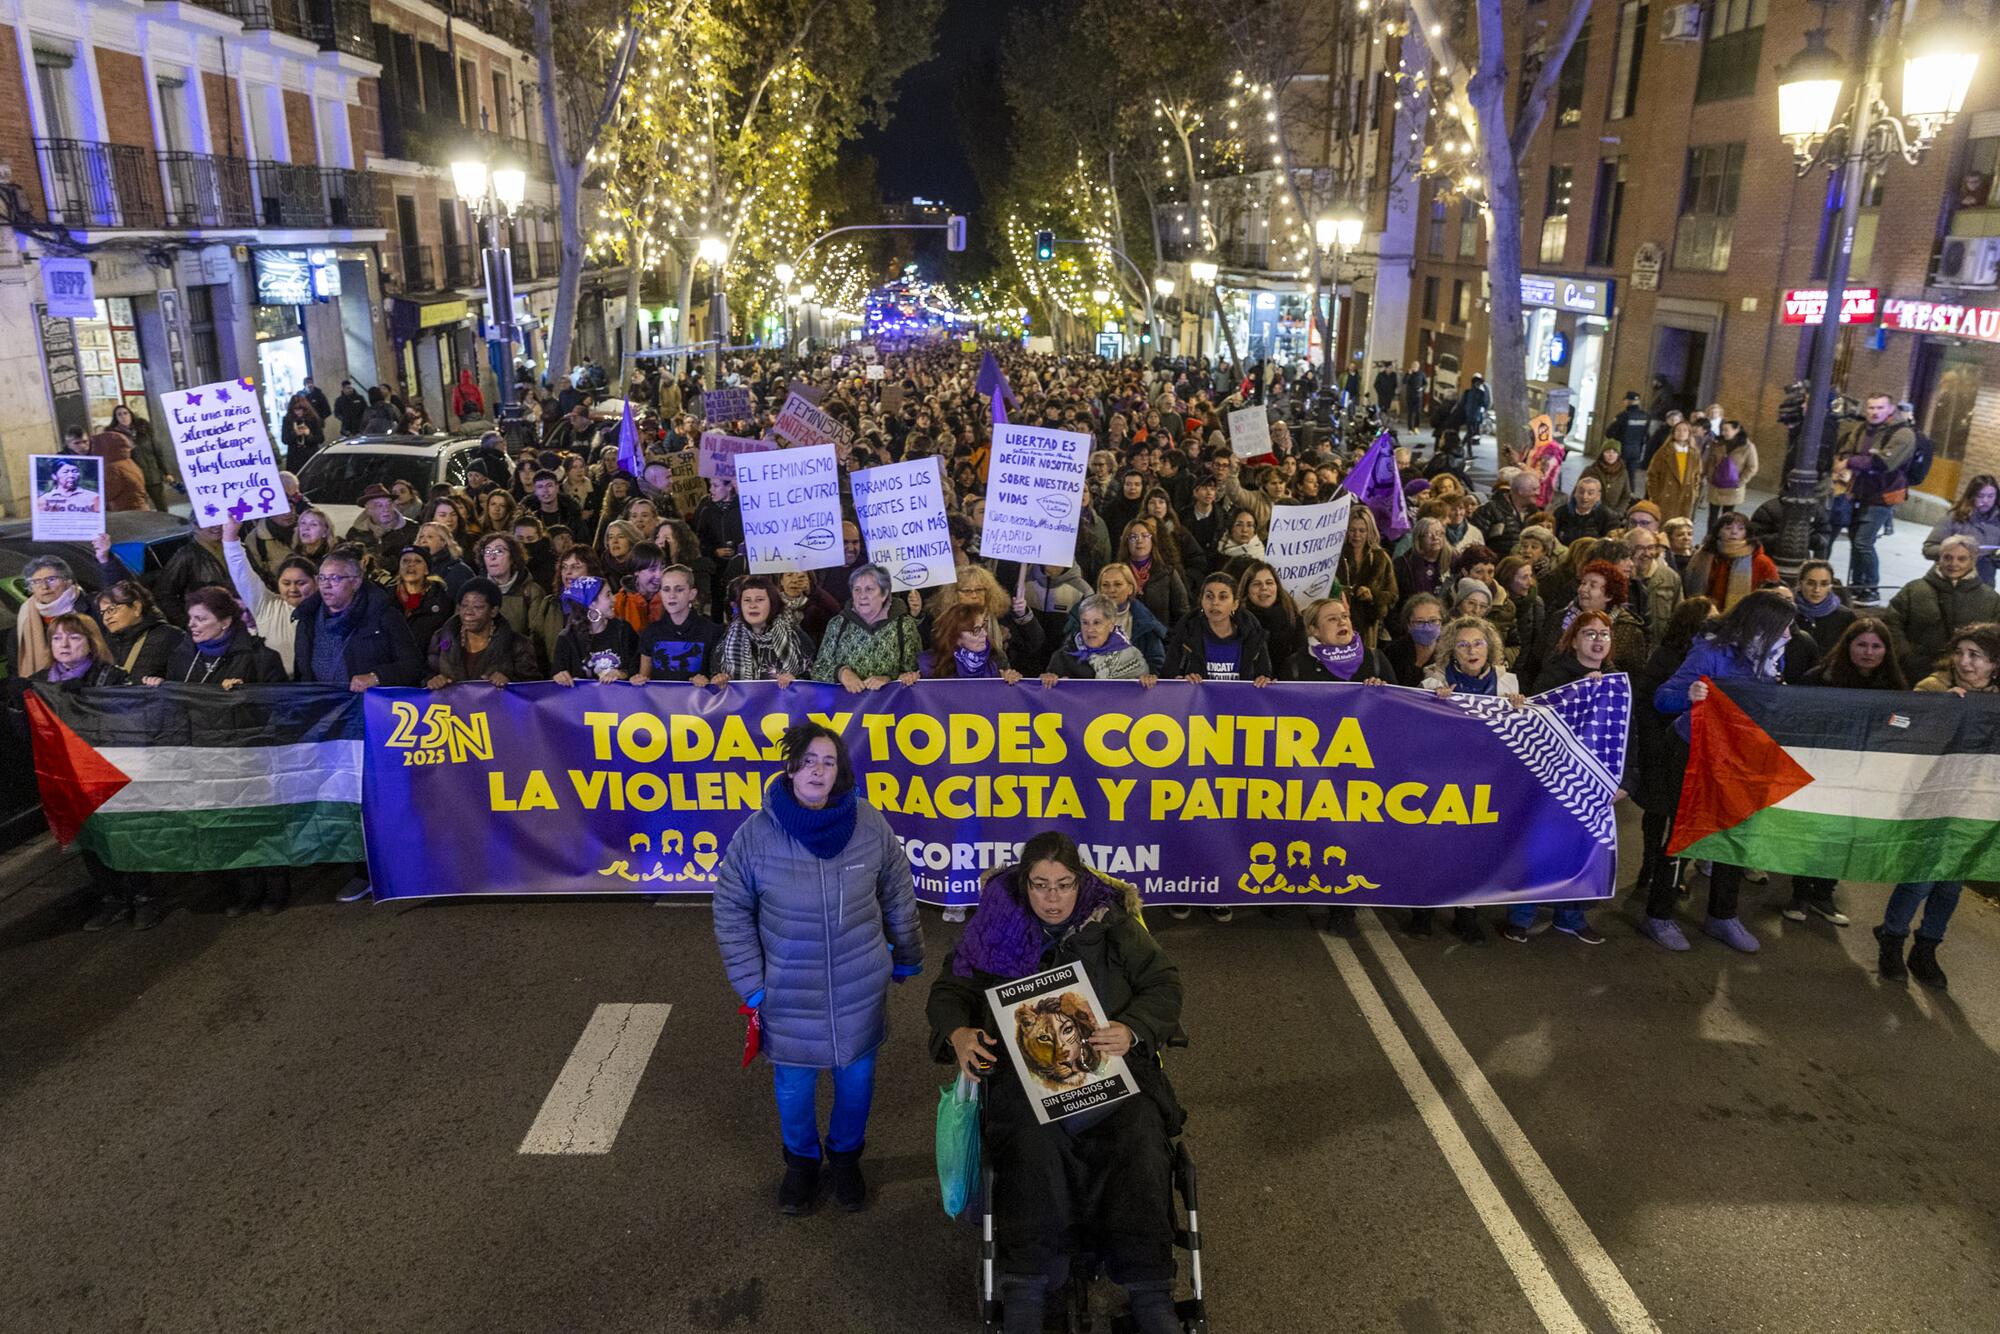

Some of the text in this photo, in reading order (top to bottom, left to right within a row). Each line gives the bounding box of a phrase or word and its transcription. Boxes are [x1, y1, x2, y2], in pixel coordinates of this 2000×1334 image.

[1786, 299, 1875, 315] VIETAM
[1899, 302, 2000, 338] RESTAU
[181, 421, 235, 443] silenciada
[787, 396, 853, 446] FEMINISTAS
[218, 436, 255, 451] tiempo
[1005, 433, 1076, 452] LIBERTAD ES
[739, 457, 834, 483] EL FEMINISMO
[1000, 453, 1036, 467] DECIDIR
[1039, 458, 1084, 474] NOSOTRAS
[854, 471, 931, 497] PARAMOS LOS
[999, 472, 1081, 493] SOBRE NUESTRAS
[742, 495, 760, 511] EN
[768, 492, 785, 508] EL
[857, 495, 928, 519] RECORTES EN
[999, 491, 1028, 506] VIDAS
[744, 511, 834, 535] AYUSO Y ALMEIDA
[862, 511, 948, 542] MADRID CON MÁS
[985, 528, 1033, 545] ¡MADRID
[1266, 542, 1276, 556] A
[1281, 536, 1326, 557] VUESTRO
[750, 546, 758, 562] A
[895, 540, 952, 562] FEMINISTA
[992, 543, 1042, 558] FEMINISTA!
[1274, 565, 1308, 580] ADRID
[385, 701, 495, 764] 25N
[584, 712, 1375, 768] TODAS Y TODES CONTRA
[403, 749, 445, 767] 2025
[488, 769, 1499, 825] LA VIOLEN RACISTA Y PATRIARCAL
[896, 834, 1160, 872] CORTES ATAN
[912, 872, 982, 893] vimient
[1145, 876, 1219, 894] Madrid
[1001, 969, 1073, 999] NO Hay FUTURO
[1043, 1078, 1116, 1108] SIN ESPACIOS de
[1063, 1092, 1108, 1113] IGUALDAD
